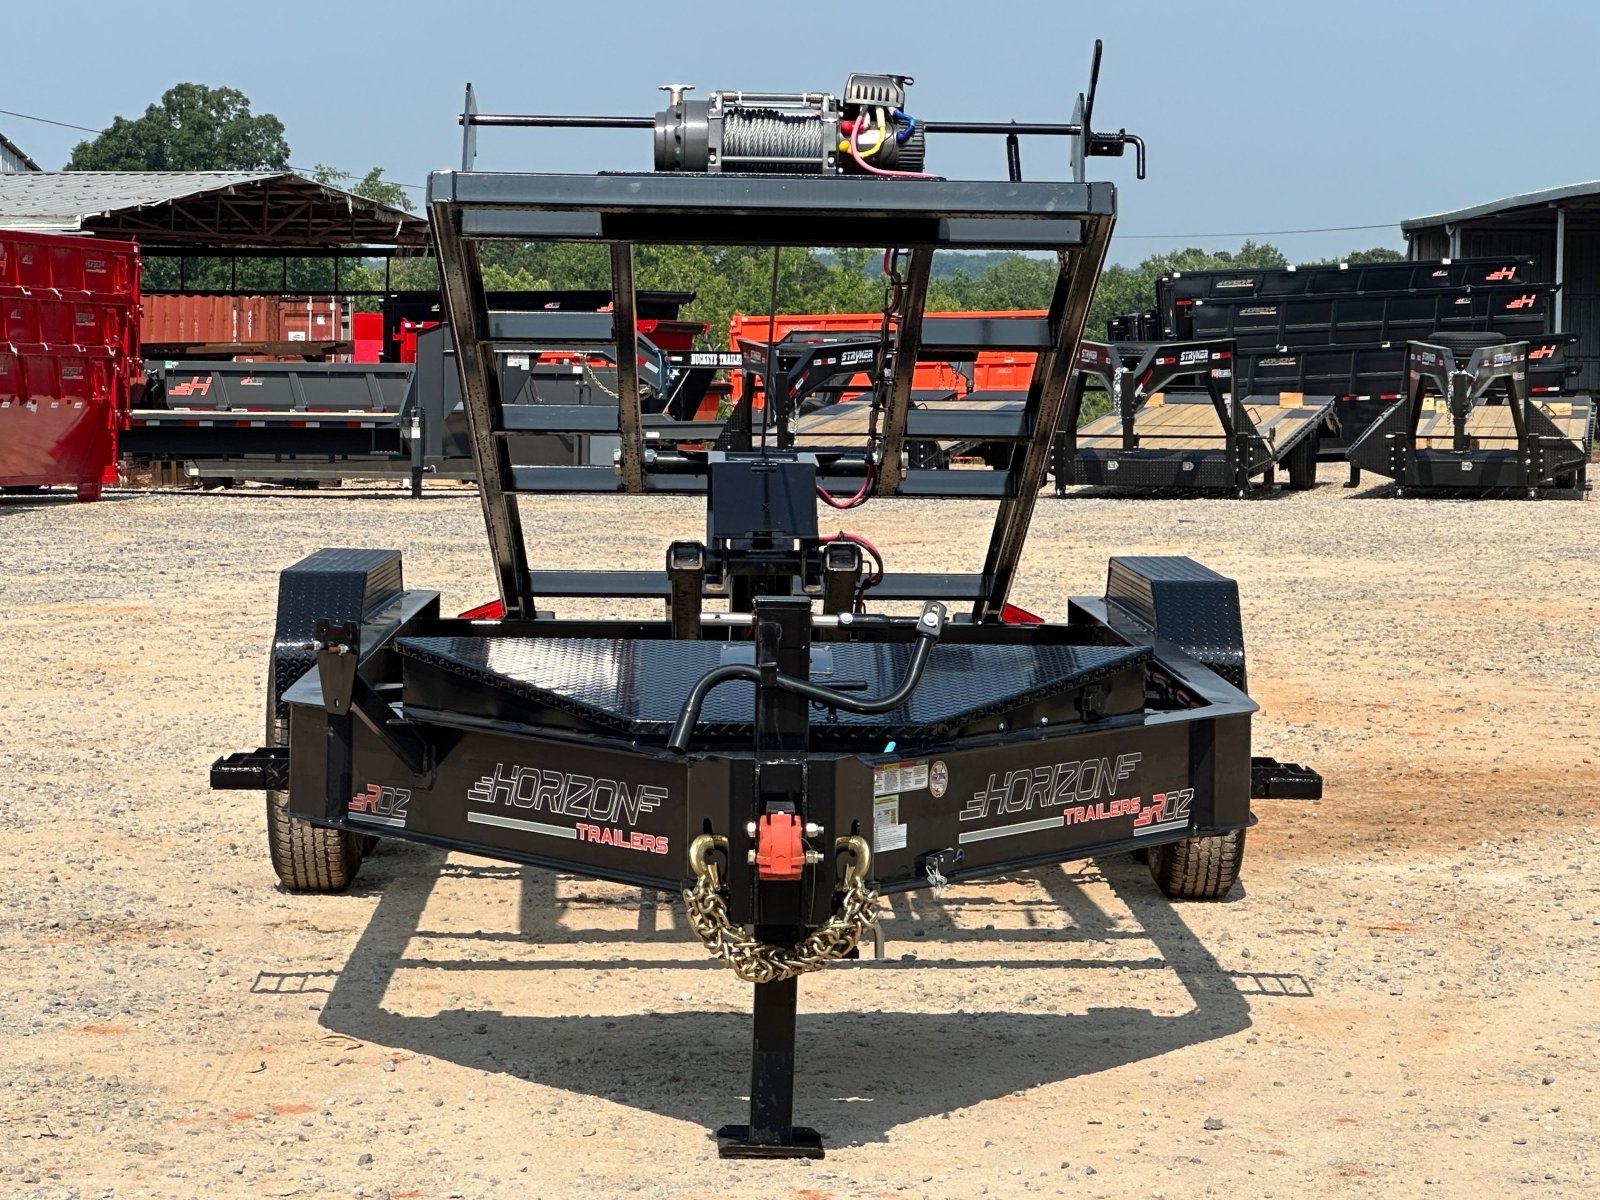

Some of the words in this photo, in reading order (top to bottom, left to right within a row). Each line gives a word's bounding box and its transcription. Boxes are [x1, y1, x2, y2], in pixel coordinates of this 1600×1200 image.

[690, 353, 718, 366] BUCKEYE
[842, 349, 874, 362] STRYKER
[1180, 350, 1209, 362] STRYKER
[361, 783, 412, 818] RDZ
[487, 763, 646, 826] HORIZON
[980, 754, 1124, 817] HORIZON
[1063, 796, 1141, 826] TRAILERS
[1148, 787, 1195, 823] RDZ
[575, 822, 669, 855] TRAILERS
